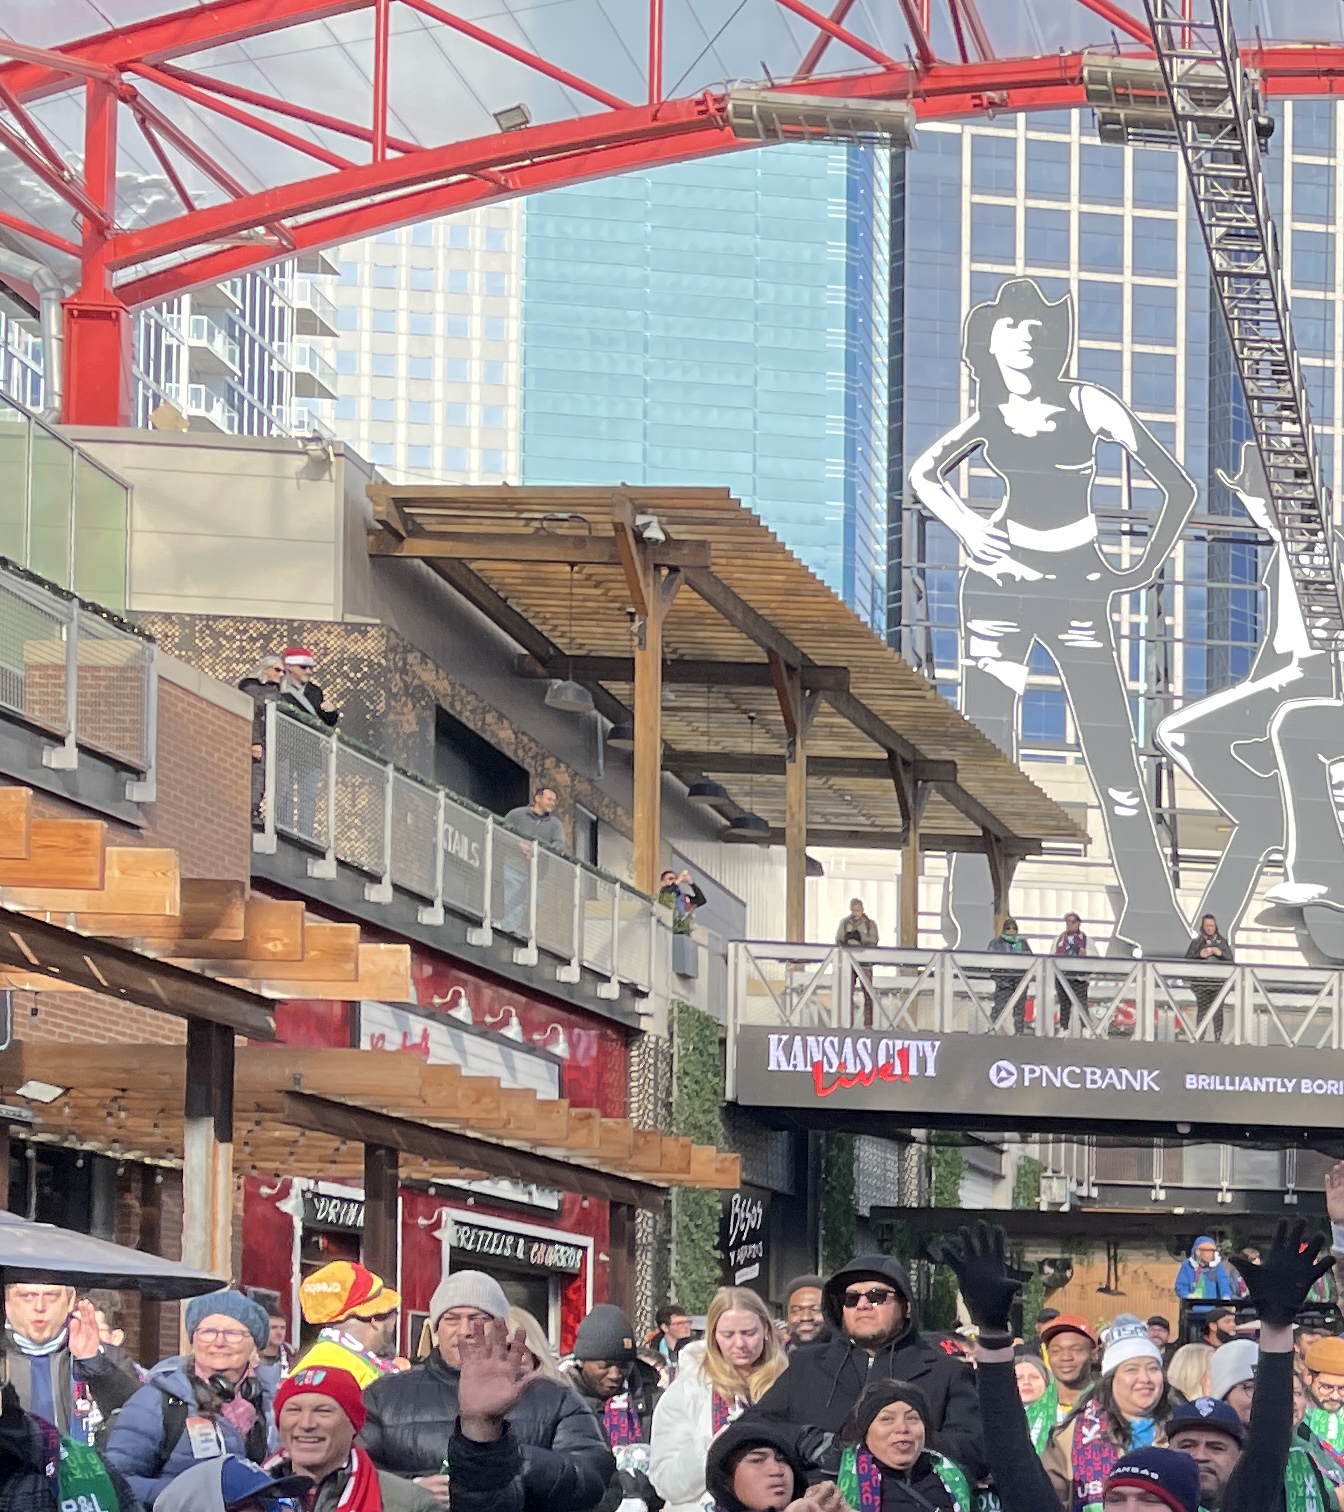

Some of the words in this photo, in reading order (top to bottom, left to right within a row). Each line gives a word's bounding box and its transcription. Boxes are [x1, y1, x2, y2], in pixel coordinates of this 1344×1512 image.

[768, 1034, 872, 1076] KANSAS
[877, 1039, 941, 1078] CITY
[812, 1047, 911, 1096] Live!
[1022, 1065, 1083, 1090] PNC
[1085, 1066, 1161, 1092] BANK
[1185, 1073, 1297, 1094] BRILLIANTLY
[1077, 1480, 1103, 1499] US
